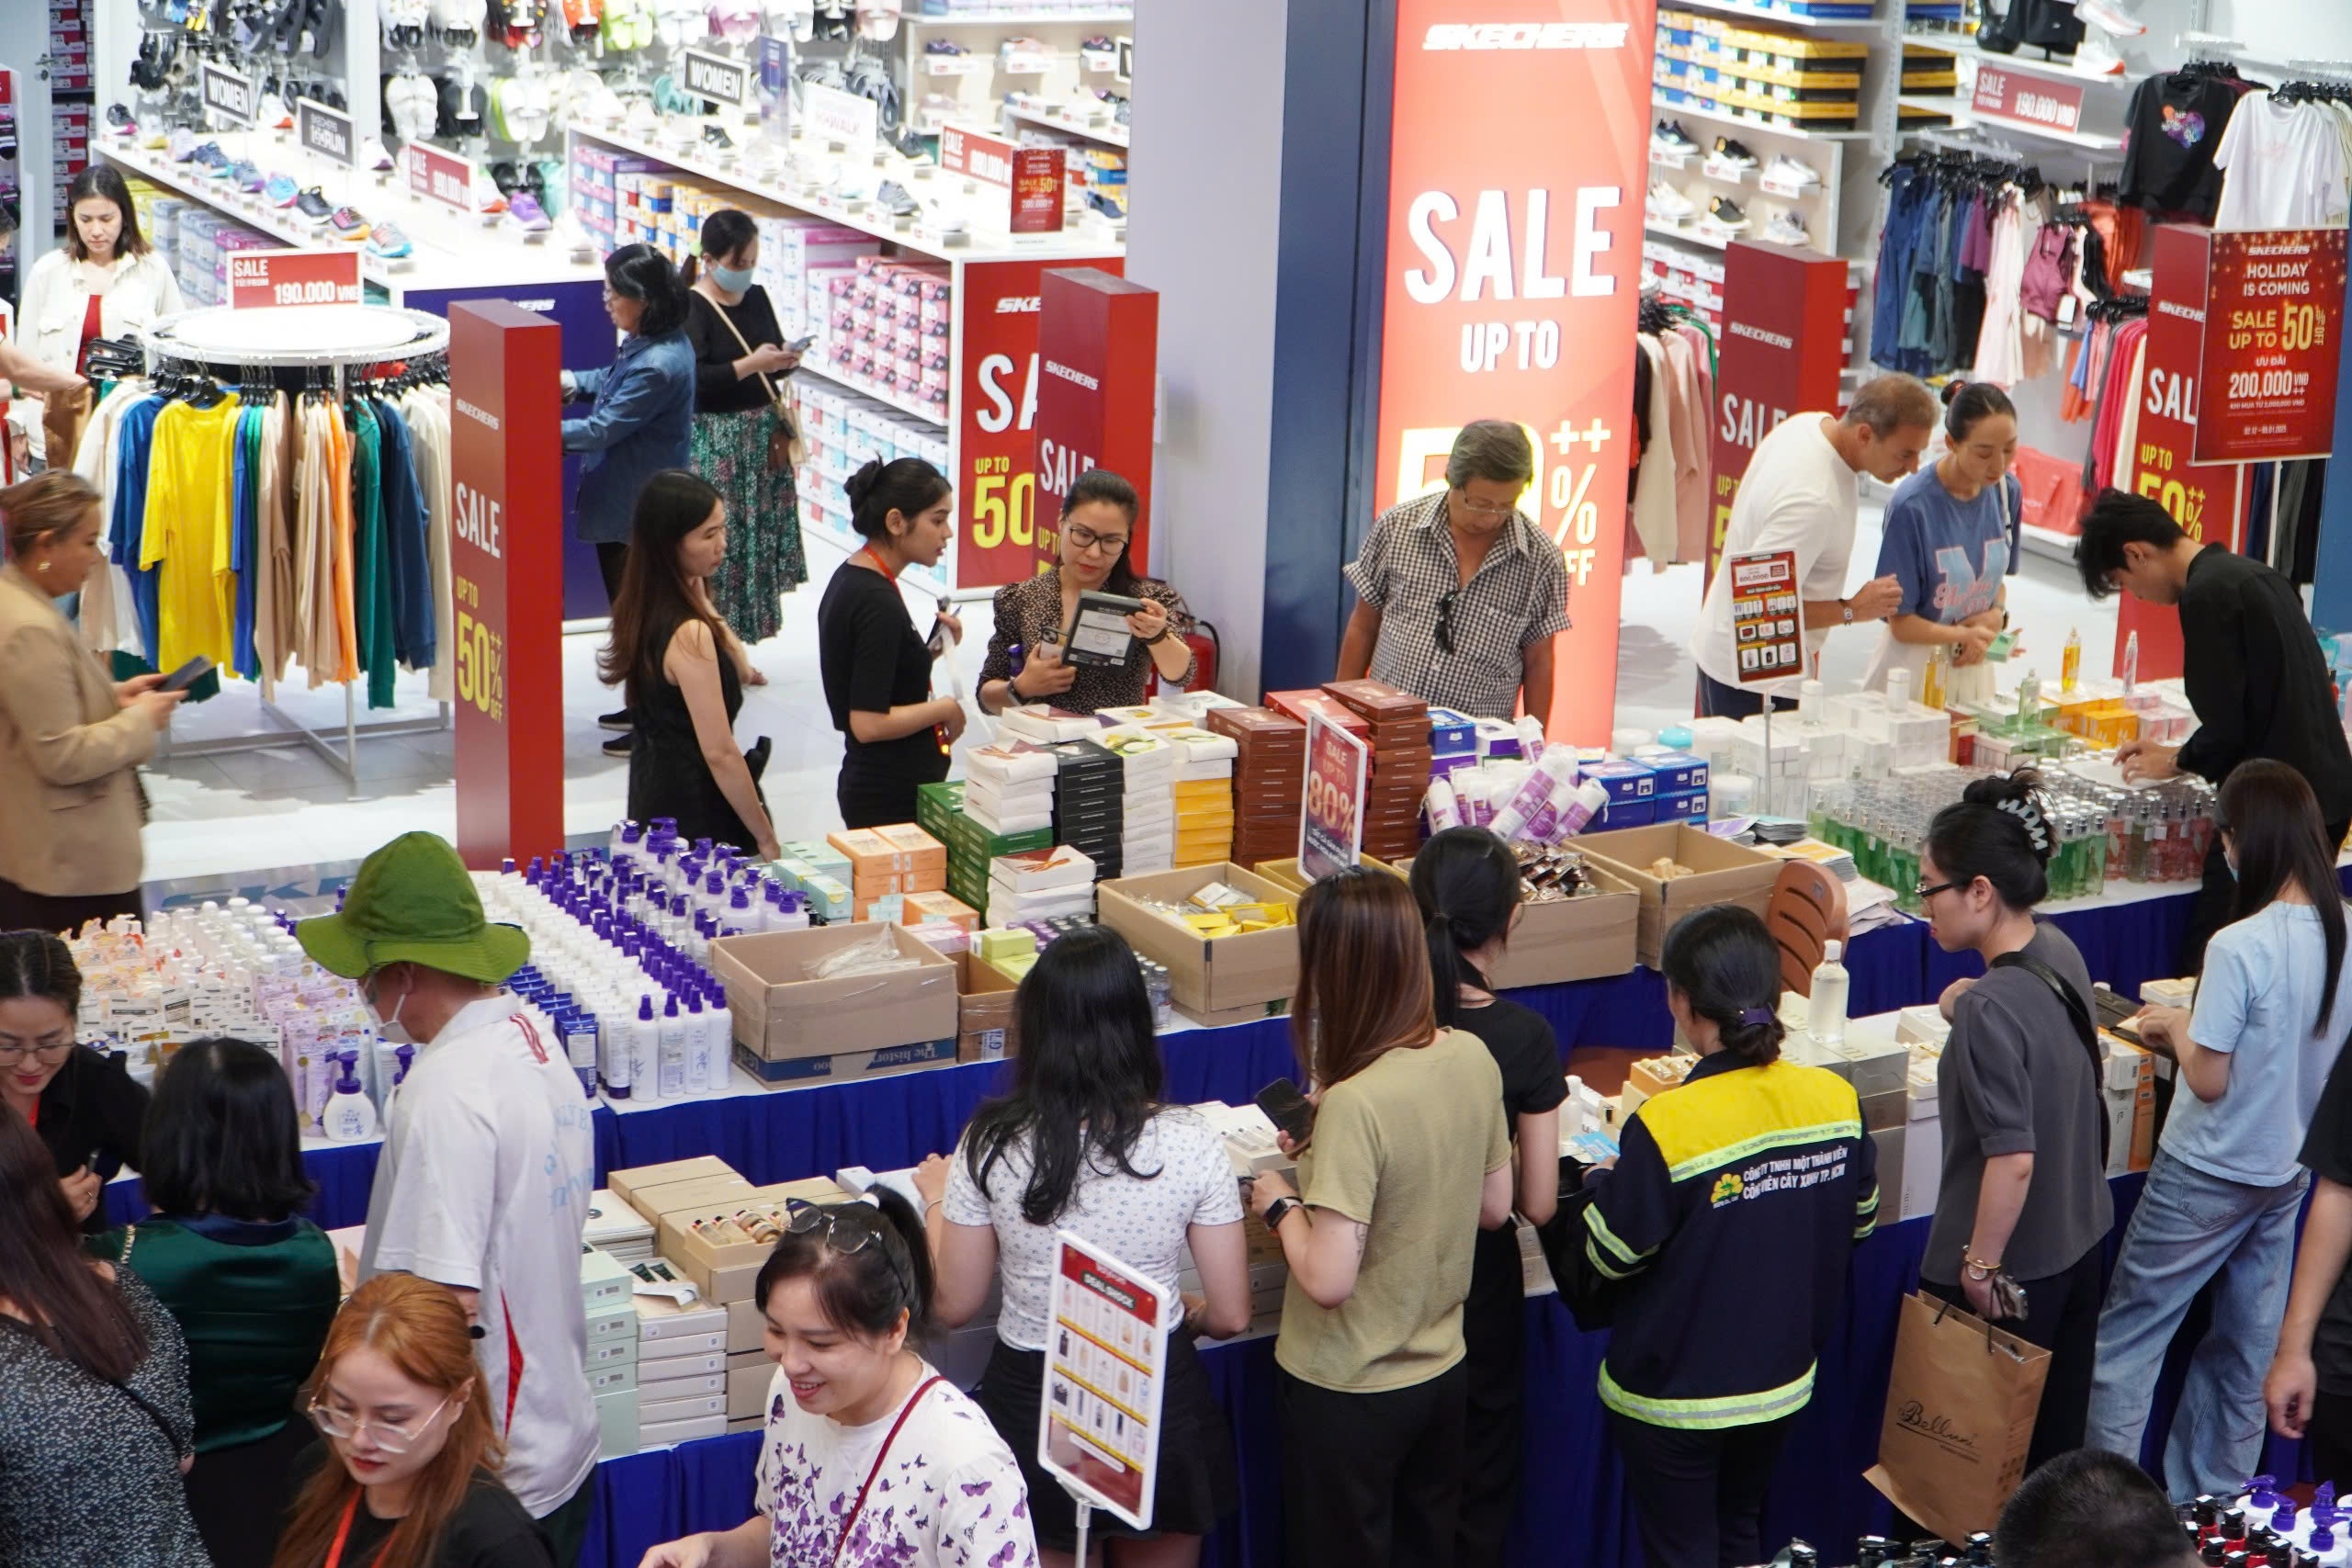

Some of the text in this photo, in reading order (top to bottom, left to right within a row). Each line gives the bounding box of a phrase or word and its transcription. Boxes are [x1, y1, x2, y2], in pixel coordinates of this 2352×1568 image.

[1423, 23, 1629, 50] SKECHERS
[691, 60, 741, 100] WOMEN
[1978, 73, 2007, 96] SALE
[208, 73, 249, 114] WOMEN
[944, 130, 964, 155] SALE
[1405, 186, 1620, 303] SALE
[2248, 245, 2311, 255] SKECHERS
[234, 259, 268, 277] SALE
[2247, 263, 2308, 278] HOLIDAY
[274, 281, 335, 304] 190.000
[2244, 281, 2310, 297] IS COMING
[2233, 310, 2277, 330] SALE
[2282, 304, 2313, 351] 50
[1461, 320, 1559, 373] UP TO
[1728, 322, 1792, 350] SKECHERS
[2229, 332, 2277, 349] UP TO
[1045, 359, 1099, 390] SKECHERS
[2228, 370, 2292, 399] 200,000
[456, 399, 499, 431] SKECHERS
[975, 456, 1010, 475] UP TO
[2141, 443, 2173, 471] UP TO
[1717, 475, 1732, 497] UP
[456, 481, 501, 558] SALE
[1038, 526, 1050, 551] UP
[457, 575, 479, 609] UP TO
[458, 610, 491, 713] 50
[491, 698, 503, 724] OFF
[1326, 741, 1348, 767] SALE
[1323, 759, 1348, 786] UP TO
[1770, 1159, 1792, 1173] TNHH
[1792, 1155, 1811, 1171] MỘT
[1780, 1174, 1799, 1190] CÂY
